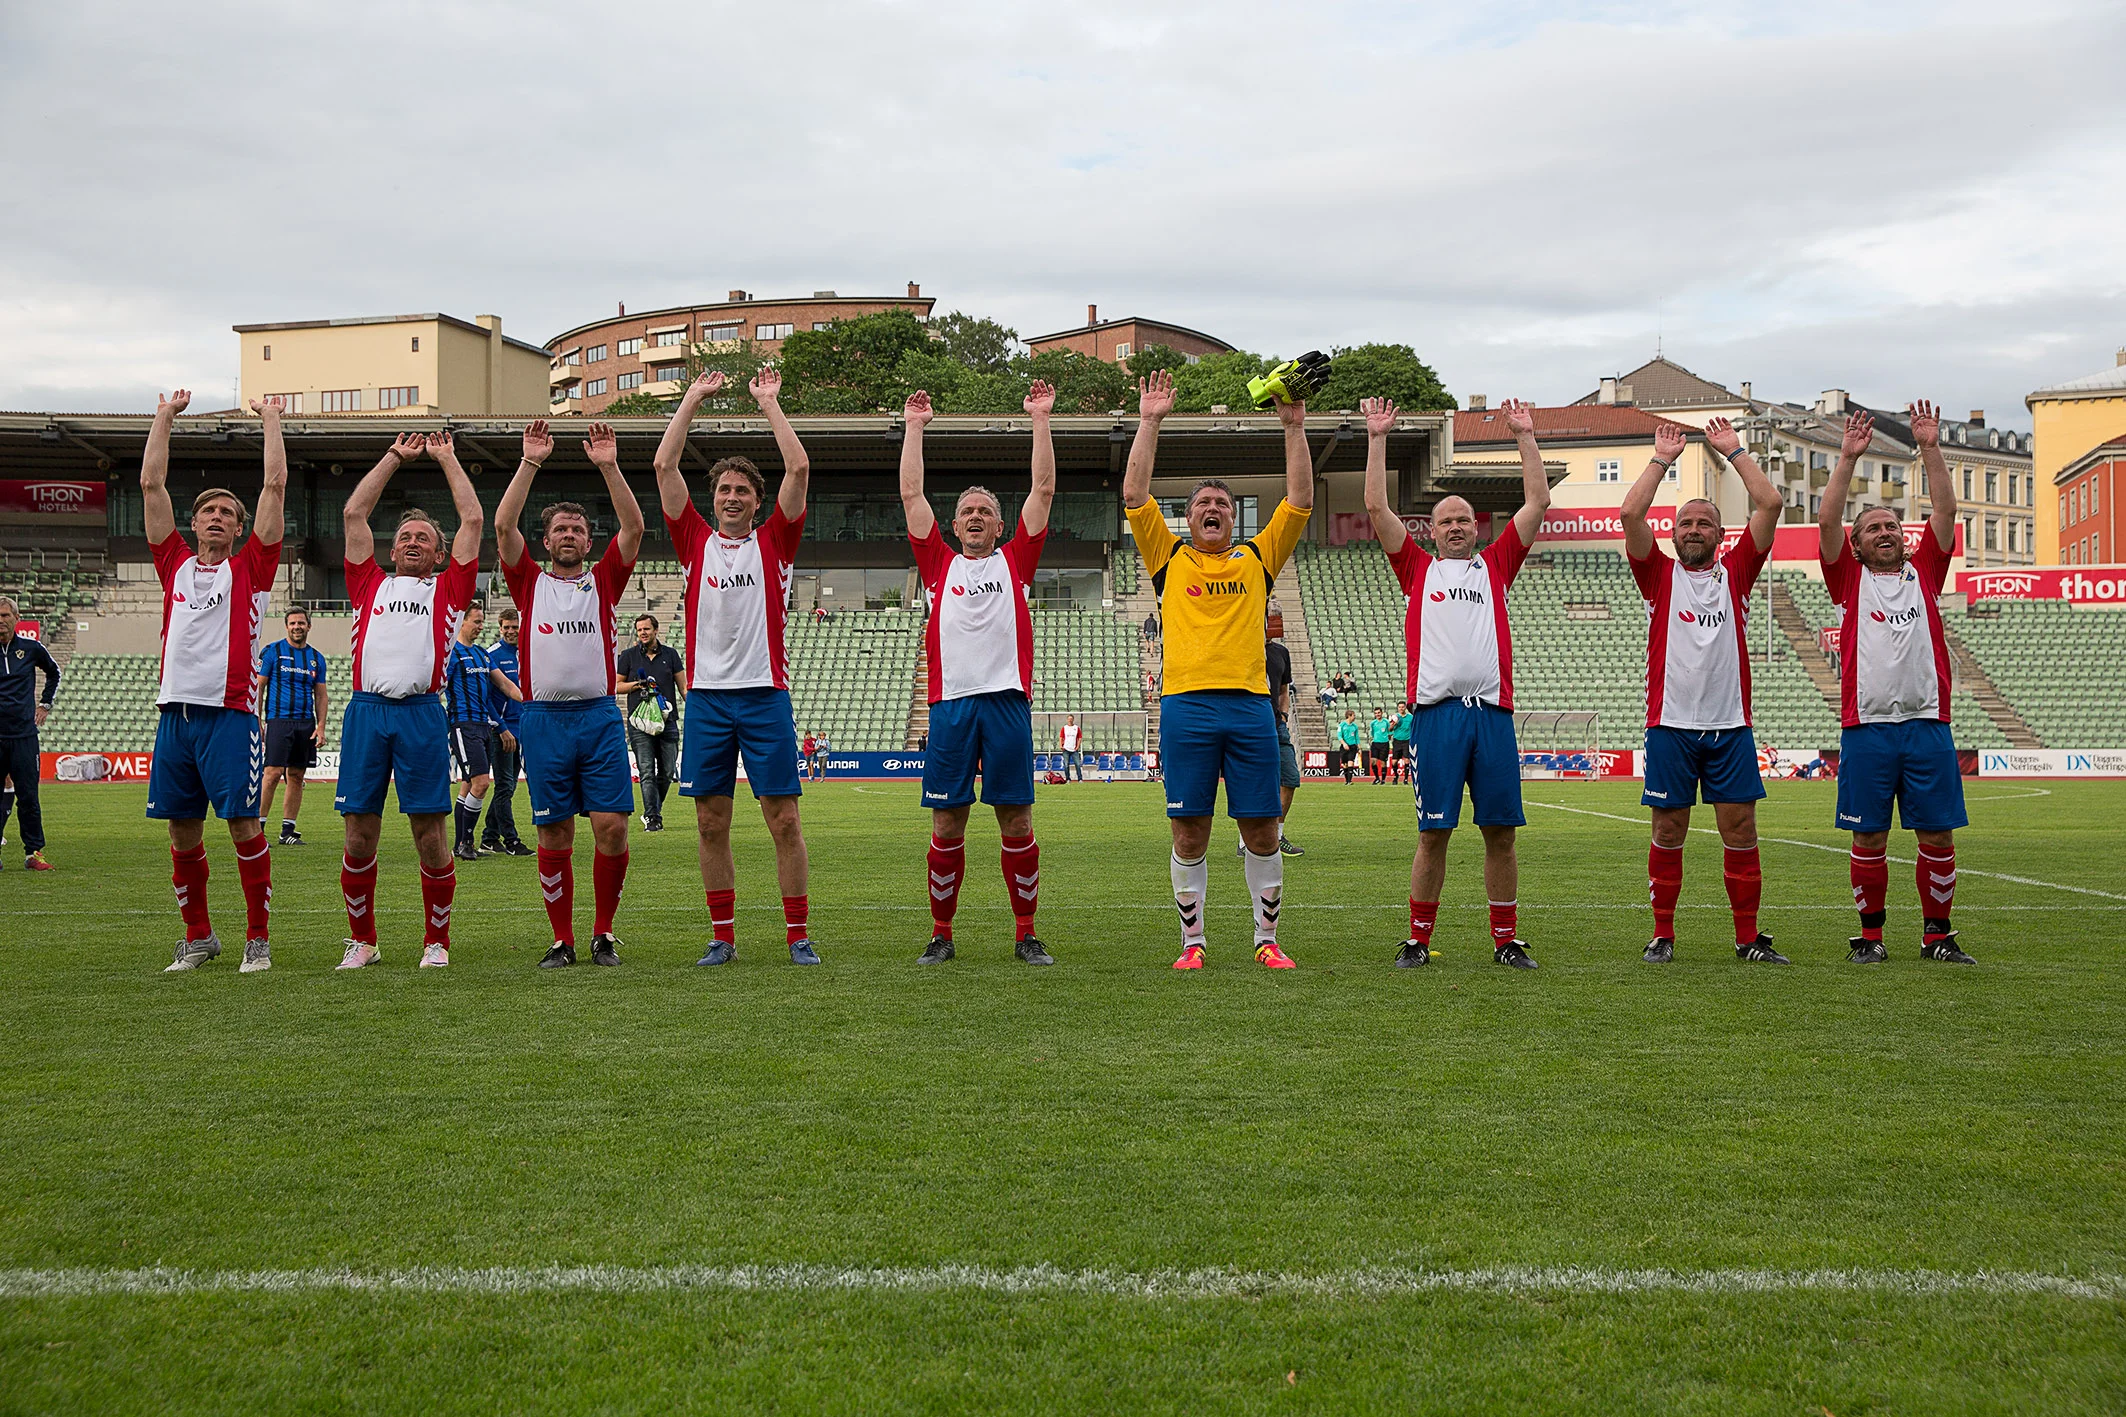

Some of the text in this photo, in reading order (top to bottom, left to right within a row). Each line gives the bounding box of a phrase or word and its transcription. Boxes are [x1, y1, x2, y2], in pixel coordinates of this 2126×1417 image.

[26, 484, 91, 502] THON
[39, 502, 79, 513] HOTELS
[1402, 515, 1433, 533] ON
[720, 573, 756, 590] VSMA
[968, 581, 1003, 596] VSMA
[1205, 581, 1247, 595] VISMA
[1968, 573, 2040, 594] THON
[389, 601, 430, 616] VISMA
[556, 620, 597, 635] VISMA
[813, 761, 860, 770] HUNDAI
[1305, 752, 1327, 768] JOB
[1984, 755, 2009, 771] DN
[2067, 755, 2092, 771] DN
[1304, 768, 1331, 777] ZONE
[1340, 768, 1366, 777] ZNE
[925, 791, 949, 800] hummel
[1645, 788, 1668, 799] hummel
[1839, 812, 1862, 824] hummel
